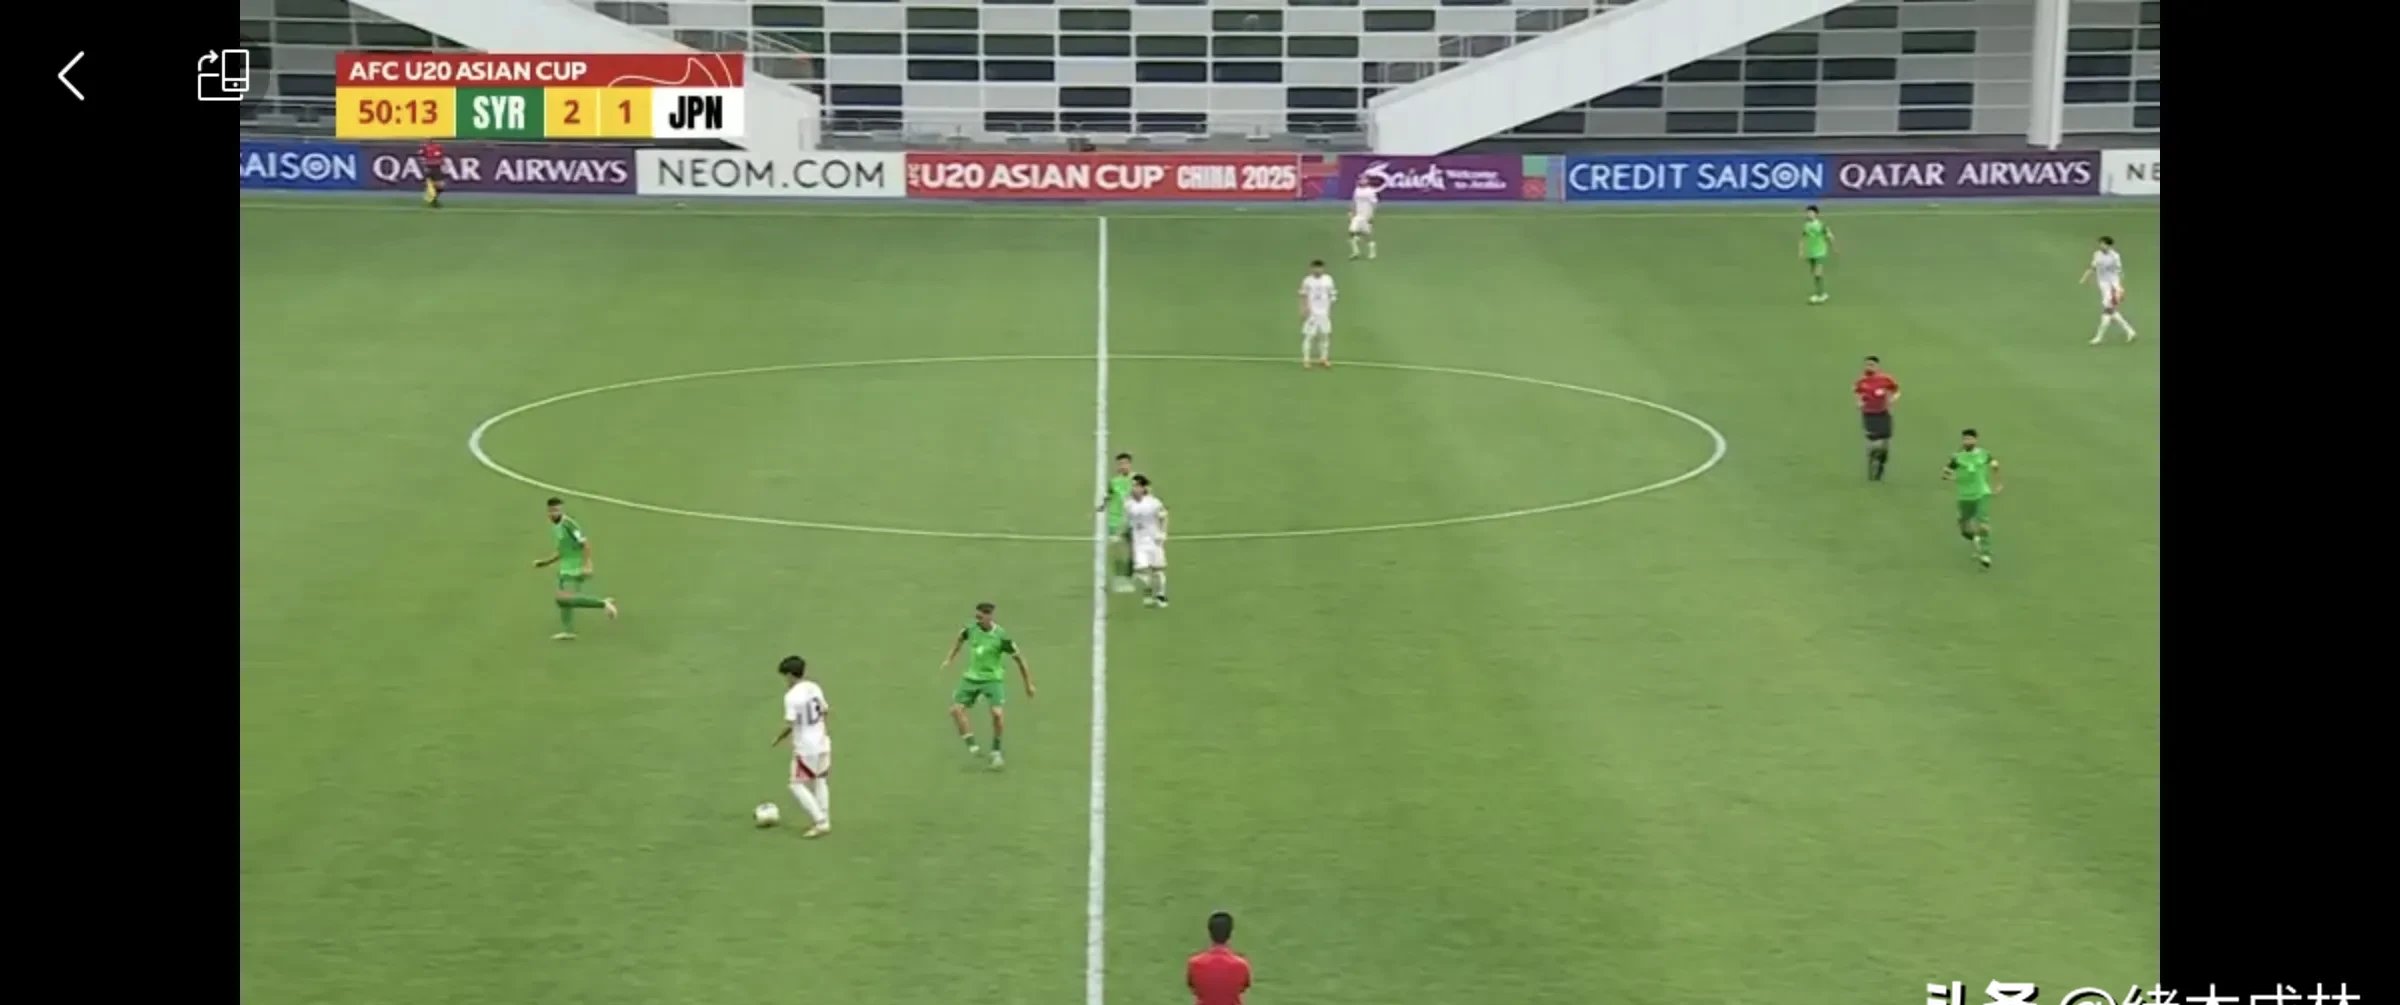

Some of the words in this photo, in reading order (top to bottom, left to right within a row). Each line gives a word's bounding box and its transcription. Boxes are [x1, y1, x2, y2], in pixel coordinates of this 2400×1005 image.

[372, 155, 482, 182] QAAR
[495, 158, 628, 184] AIRWAYS
[658, 158, 884, 189] NEOM.COM
[921, 163, 985, 189] U20
[987, 163, 1091, 189] ASIAN
[1095, 164, 1164, 190] CUP
[1176, 164, 1238, 191] CHINA
[1241, 164, 1296, 191] 2025
[1569, 163, 1689, 191] CREDIT
[1697, 163, 1824, 191] SAISON
[1840, 163, 1945, 190] QATAR
[1957, 161, 2091, 185] AIRWAYS
